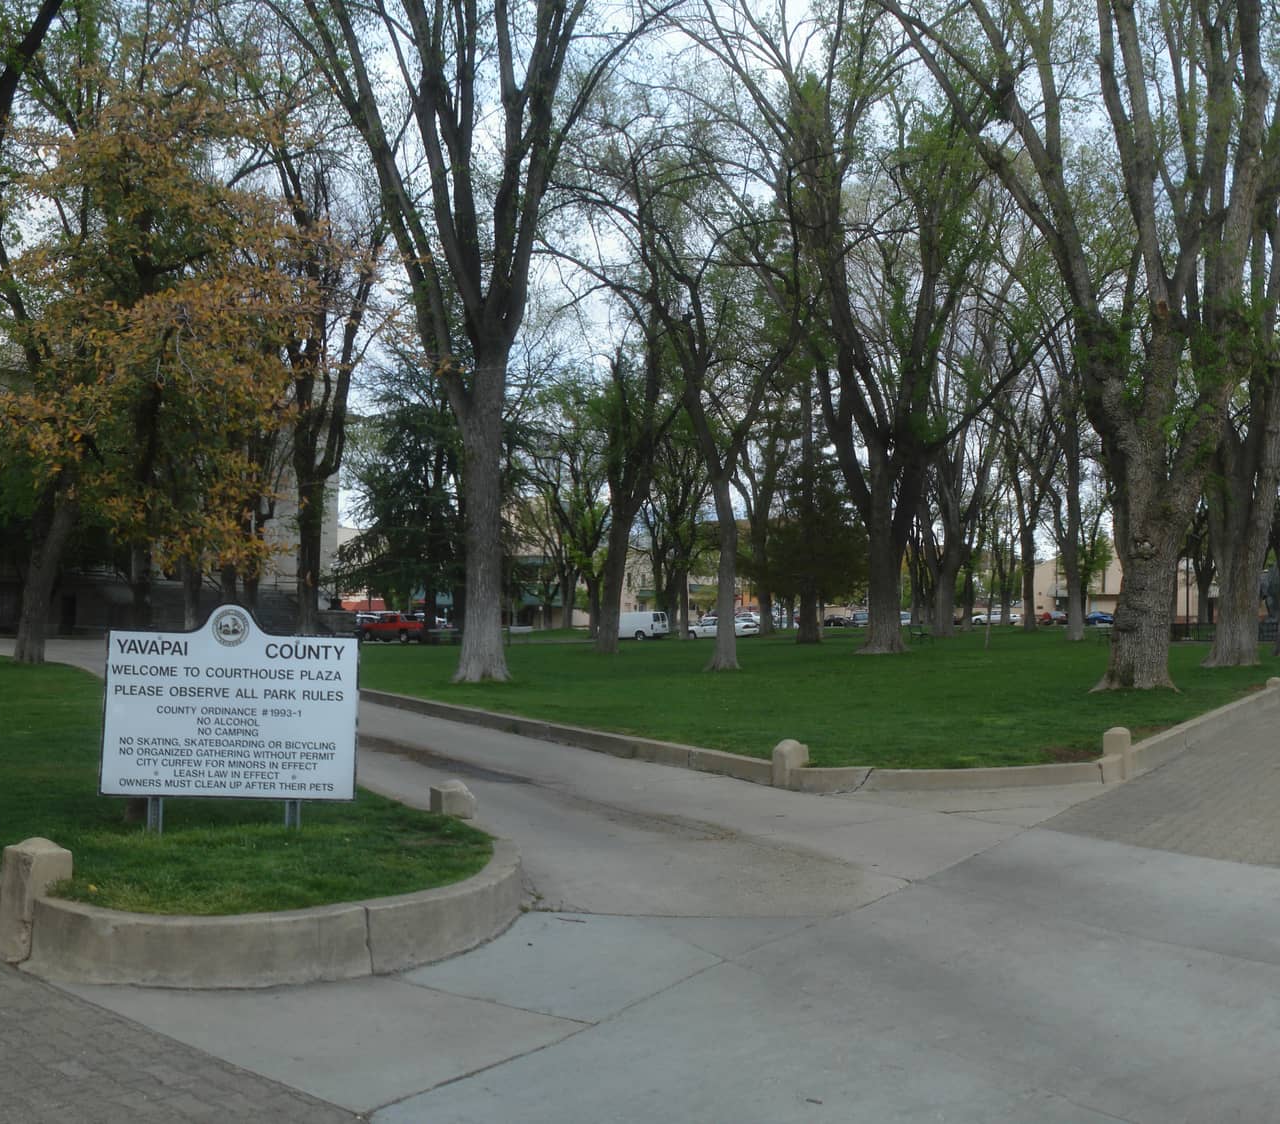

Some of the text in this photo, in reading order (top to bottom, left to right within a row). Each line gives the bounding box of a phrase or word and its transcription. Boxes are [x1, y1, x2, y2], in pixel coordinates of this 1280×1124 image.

[116, 638, 344, 660] YAVAPAI COUNTY
[112, 664, 342, 681] WELCOME TO COURTHOUSE PLAZA
[114, 684, 344, 701] PLEASE OBSERVE ALL PARK RULES
[156, 706, 196, 714] COUNTY
[200, 707, 257, 716] ORDINANCE
[197, 717, 260, 726] NO ALCOHOL
[198, 728, 259, 737] NO CAMPING
[119, 737, 134, 745] NO
[184, 738, 265, 749] SKATEBOARDING
[268, 740, 282, 749] OR
[285, 741, 336, 751] BICYCLING
[119, 747, 336, 760] NO ORGANIZED GATHERING WITHOUT PERMIT
[136, 758, 158, 766] CITY
[161, 758, 202, 768] CURFEW
[228, 761, 266, 769] MINORS
[281, 762, 318, 770] EFFECT
[173, 769, 280, 780] LEASH LAW IN EFFECT
[119, 778, 334, 792] OWNERS MUST CLEAN UP AFTER THEIR PETS
